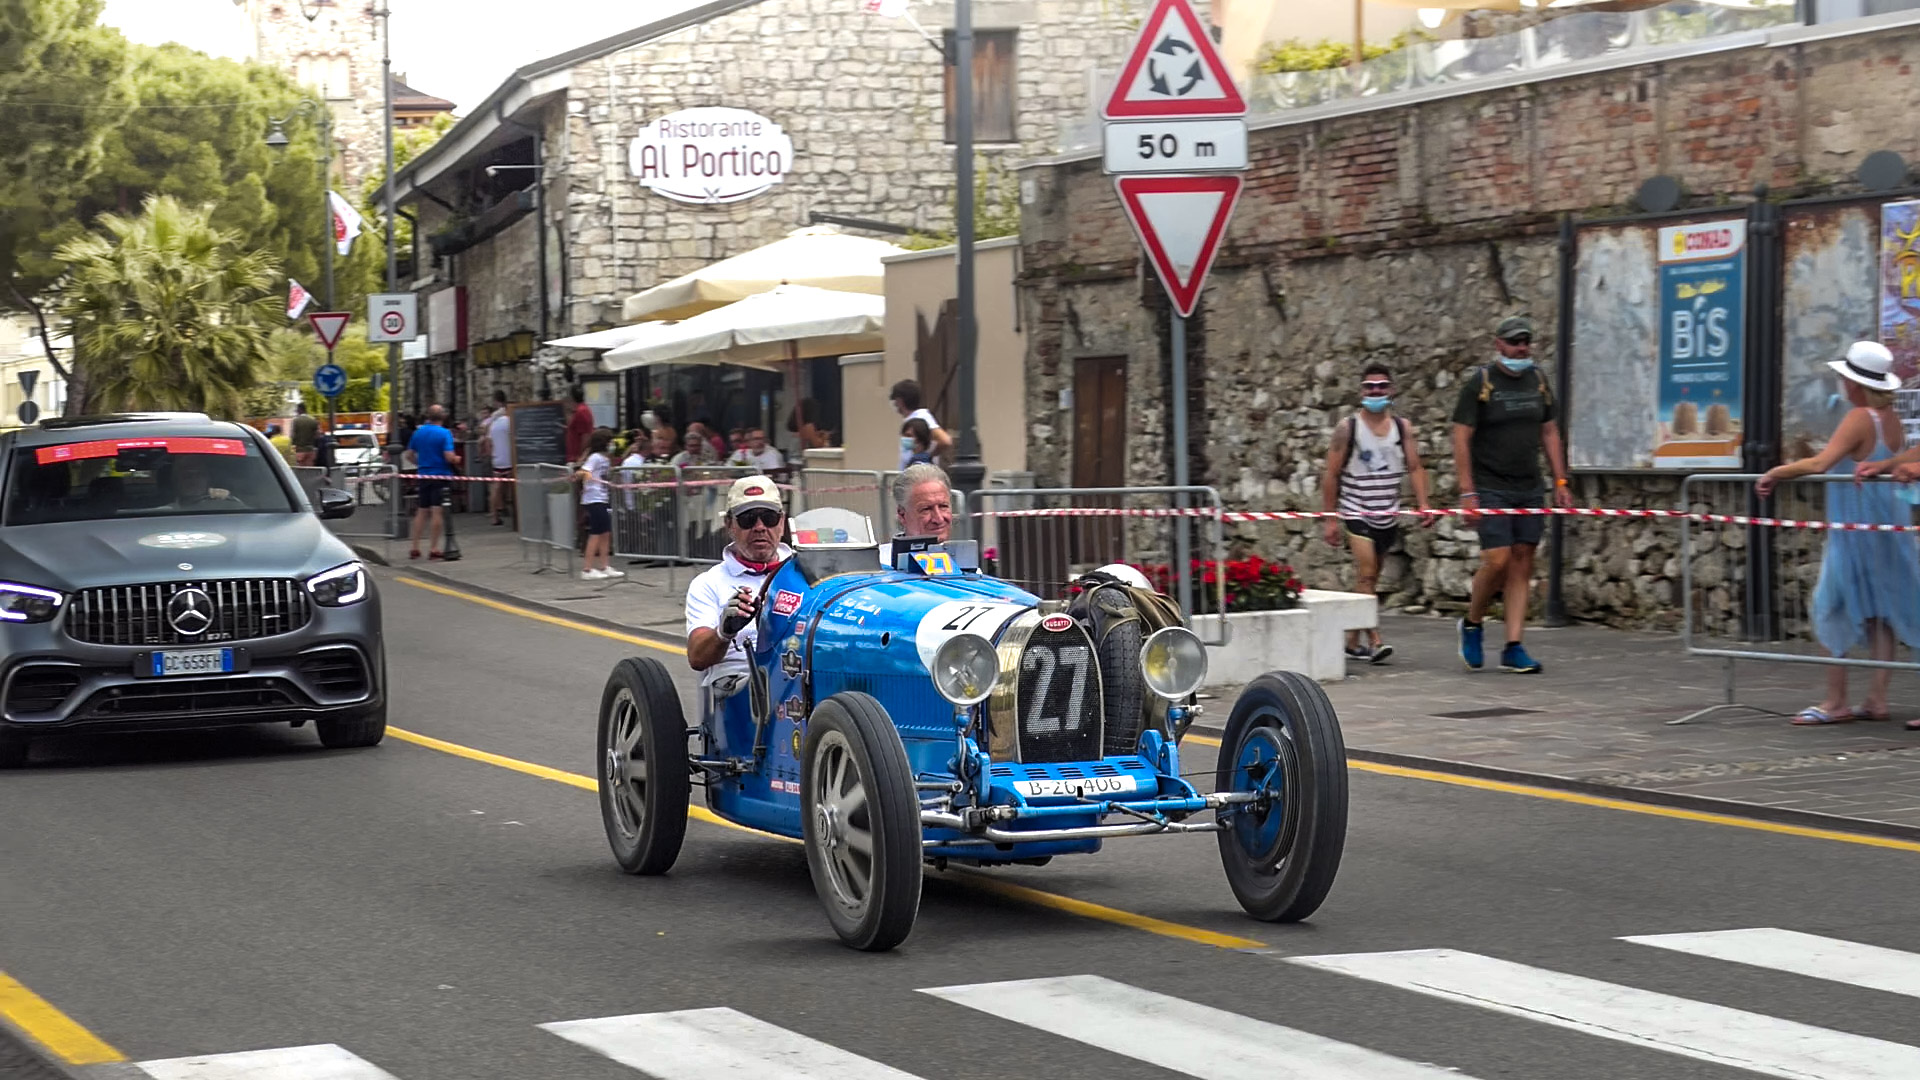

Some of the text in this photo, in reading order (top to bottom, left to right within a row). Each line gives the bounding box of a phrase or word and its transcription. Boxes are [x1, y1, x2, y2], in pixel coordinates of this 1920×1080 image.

[659, 119, 762, 139] Ristorante
[1137, 133, 1216, 159] 50 m
[641, 144, 782, 178] Al Portico
[914, 552, 954, 575] 27
[941, 606, 996, 630] 27
[1045, 620, 1070, 629] BUGATTI
[1022, 646, 1090, 733] 27
